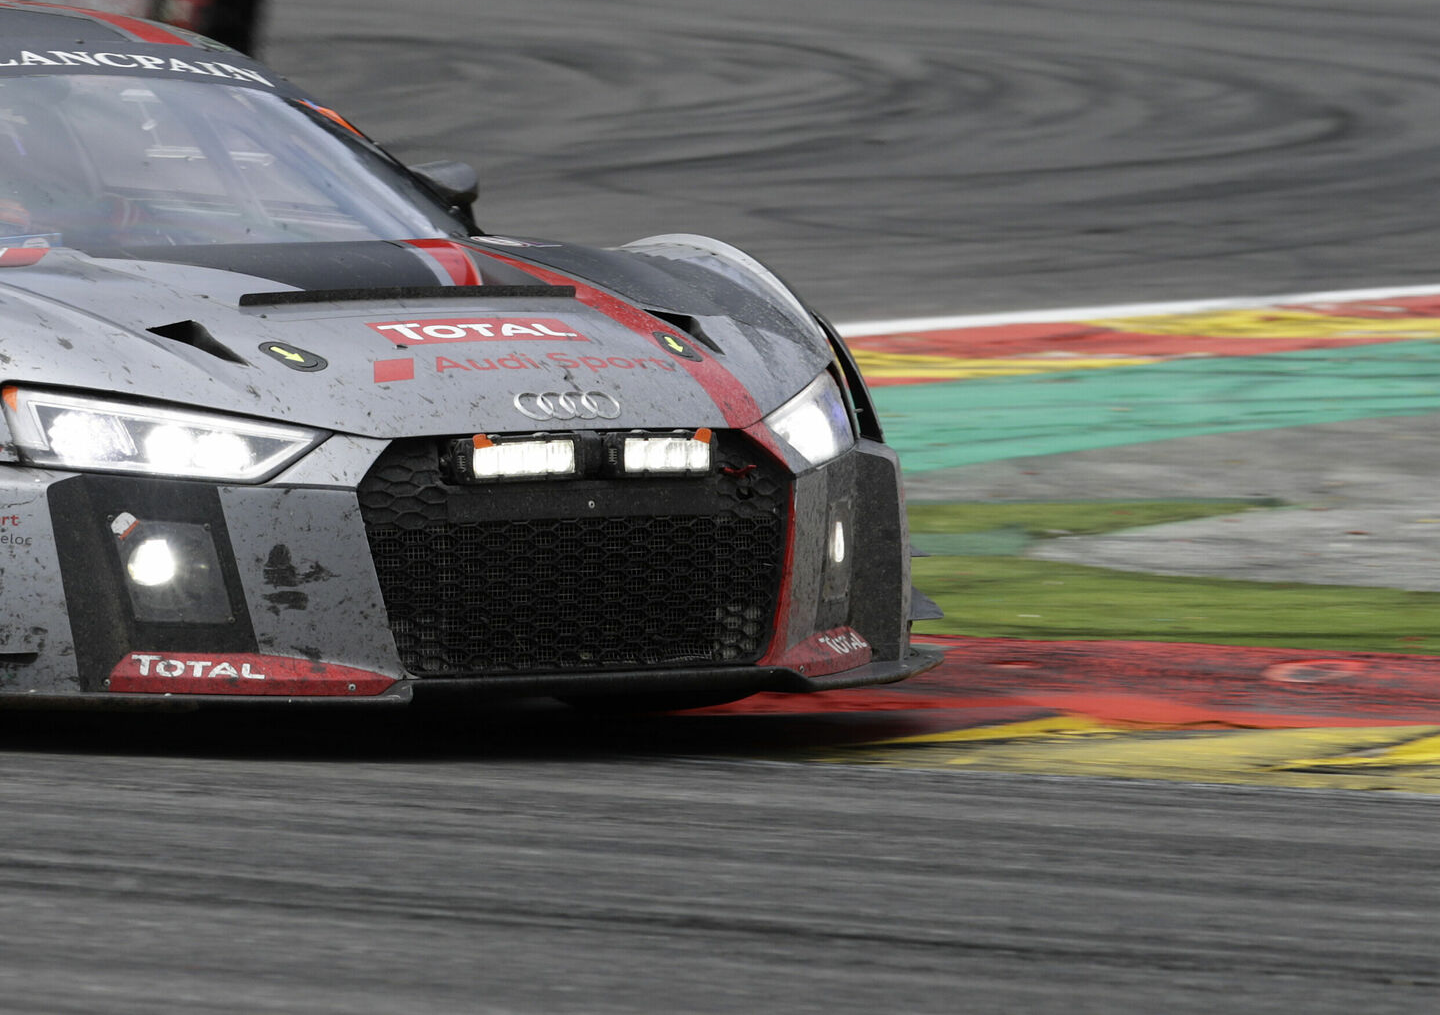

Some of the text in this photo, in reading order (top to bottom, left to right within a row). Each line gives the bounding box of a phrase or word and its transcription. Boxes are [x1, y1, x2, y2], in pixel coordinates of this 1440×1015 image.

[376, 322, 578, 341] TOTAL
[435, 352, 677, 374] Audi Sport
[818, 632, 868, 655] TOTAL
[131, 654, 266, 681] TOTAL
